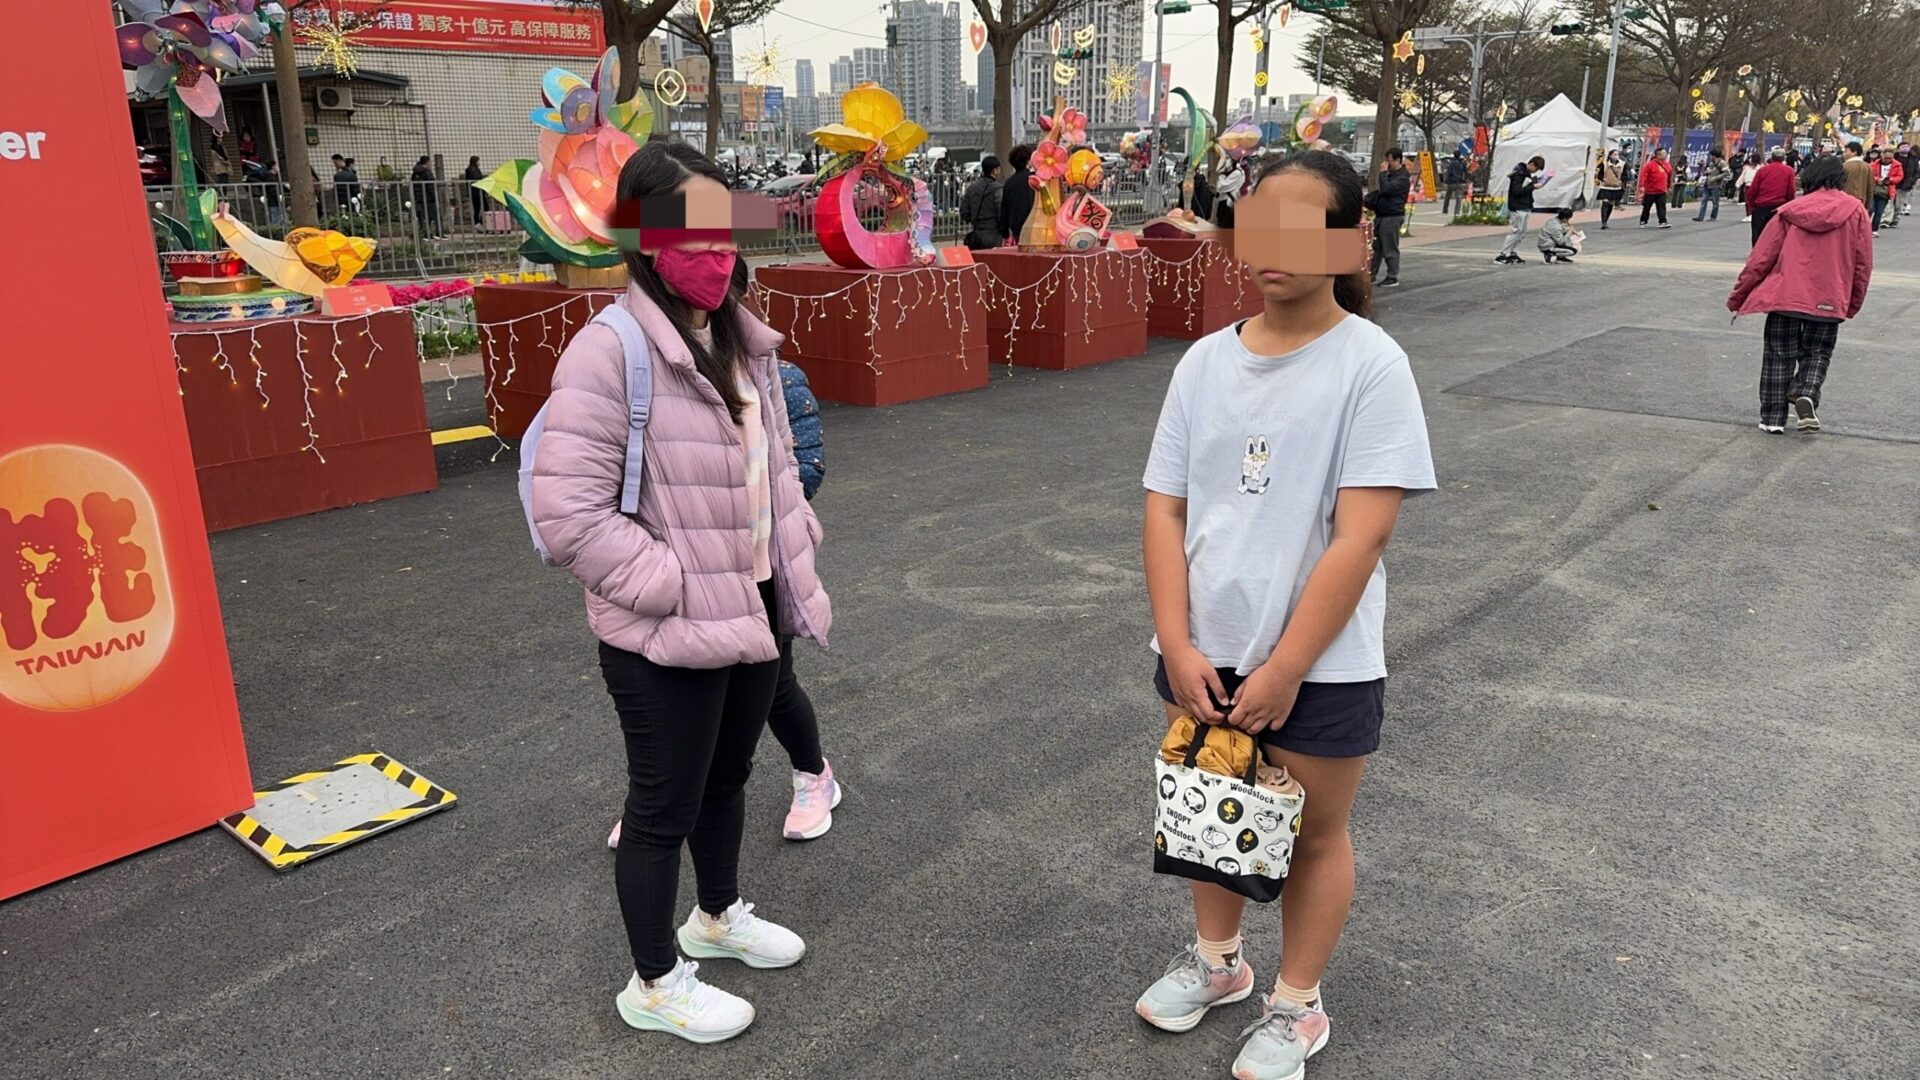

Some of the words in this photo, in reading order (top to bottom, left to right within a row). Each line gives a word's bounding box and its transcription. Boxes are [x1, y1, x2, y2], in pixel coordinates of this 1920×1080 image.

[417, 13, 506, 36] 獨家十億元
[510, 19, 592, 41] 高保障服務
[0, 131, 46, 160] er
[15, 630, 145, 675] TAIWAN
[1230, 783, 1275, 805] Woodstock
[1166, 807, 1191, 825] SNOOPY
[1162, 820, 1197, 843] Woodstock
